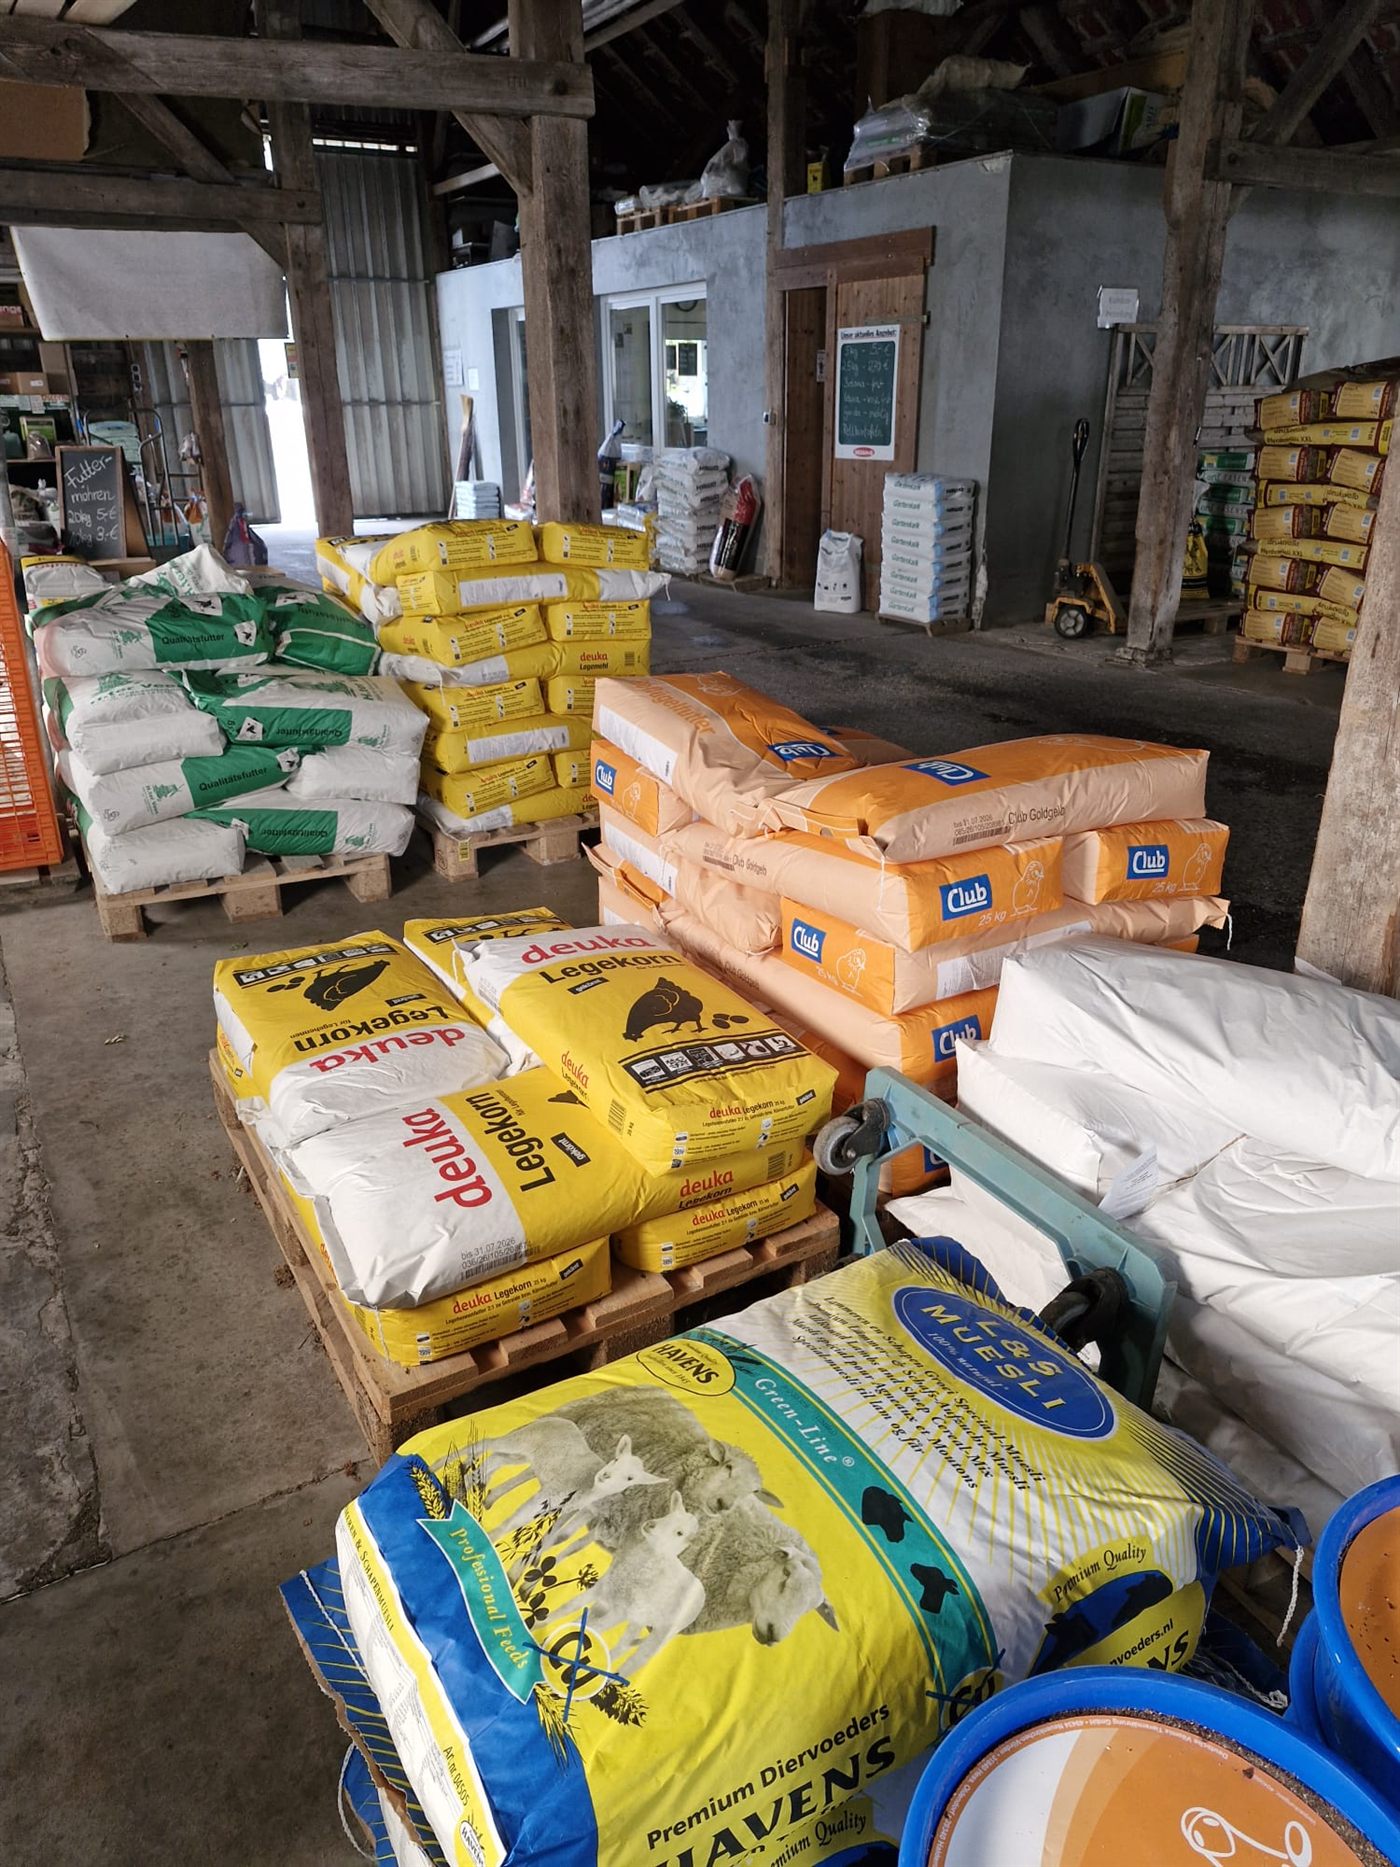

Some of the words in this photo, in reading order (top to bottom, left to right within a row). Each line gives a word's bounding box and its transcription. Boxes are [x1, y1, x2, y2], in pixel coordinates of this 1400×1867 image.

[64, 456, 112, 488] Futter-
[71, 485, 115, 503] möhren
[68, 510, 92, 527] 20kg
[161, 633, 225, 645] Qualitätsfutter
[580, 651, 608, 662] deuka
[774, 743, 831, 758] Club
[199, 767, 268, 792] Qualitätsfutter
[596, 764, 614, 791] Club
[917, 760, 974, 781] Club
[1008, 810, 1028, 826] Club
[1029, 805, 1066, 822] Goldgelb
[733, 855, 745, 869] Club
[746, 858, 768, 877] Goldgelb
[1132, 850, 1165, 875] Club
[947, 888, 988, 913] Club
[1152, 881, 1165, 893] 25
[1166, 881, 1178, 893] kg
[978, 913, 992, 928] 25
[994, 910, 1007, 924] kg
[521, 936, 656, 964] deuka
[794, 926, 819, 958] Club
[539, 954, 682, 984] Legekorn
[290, 1021, 343, 1039] Legehennen
[294, 1006, 450, 1052] Legekorn
[309, 1027, 466, 1073] deuka
[561, 1051, 590, 1089] deuka
[710, 1106, 742, 1119] deuka
[465, 1092, 556, 1192] Legekorn
[558, 1136, 587, 1161] gekörnt
[402, 1107, 493, 1208] deuka
[680, 1170, 734, 1197] deuka
[678, 1187, 733, 1209] Legekorn
[692, 1208, 726, 1226] deuka
[726, 1199, 759, 1216] Legekorn
[461, 1250, 474, 1260] bis
[474, 1238, 516, 1257] 31.07.2026
[453, 1291, 493, 1314] deuka
[493, 1280, 533, 1301] Legekorn
[920, 1304, 1067, 1411] MUESLI
[927, 1332, 957, 1356] 100%
[975, 1320, 1064, 1377] L&S
[652, 1343, 720, 1385] HAVENS
[848, 1339, 879, 1370] Lambs
[877, 1366, 901, 1384] and
[901, 1385, 931, 1415] Sheep
[931, 1415, 994, 1480] Cereal-Mix
[870, 1321, 882, 1336] en
[883, 1335, 924, 1368] Schapen
[924, 1368, 960, 1396] Groei
[953, 1395, 1046, 1483] Speciaal-Muesli
[754, 1377, 838, 1464] Green-Line
[849, 1357, 875, 1382] pour
[871, 1381, 918, 1424] Agneaux
[915, 1422, 931, 1437] et
[927, 1435, 979, 1491] Moutons
[857, 1387, 875, 1403] til
[870, 1399, 891, 1421] lam
[890, 1421, 905, 1441] og
[900, 1433, 925, 1455] får
[890, 1358, 904, 1368] &
[902, 1365, 1031, 1491] Schafs-Aufzucht-Muesli
[355, 1540, 363, 1550] &
[1103, 1542, 1148, 1570] Quality
[450, 1527, 507, 1622] Professional
[493, 1625, 531, 1671] Feeds
[455, 1773, 471, 1806] 04505
[646, 1781, 755, 1850] Premium
[759, 1704, 890, 1788] Diervoeders
[770, 1837, 812, 1867] emium
[814, 1810, 867, 1848] Quality
